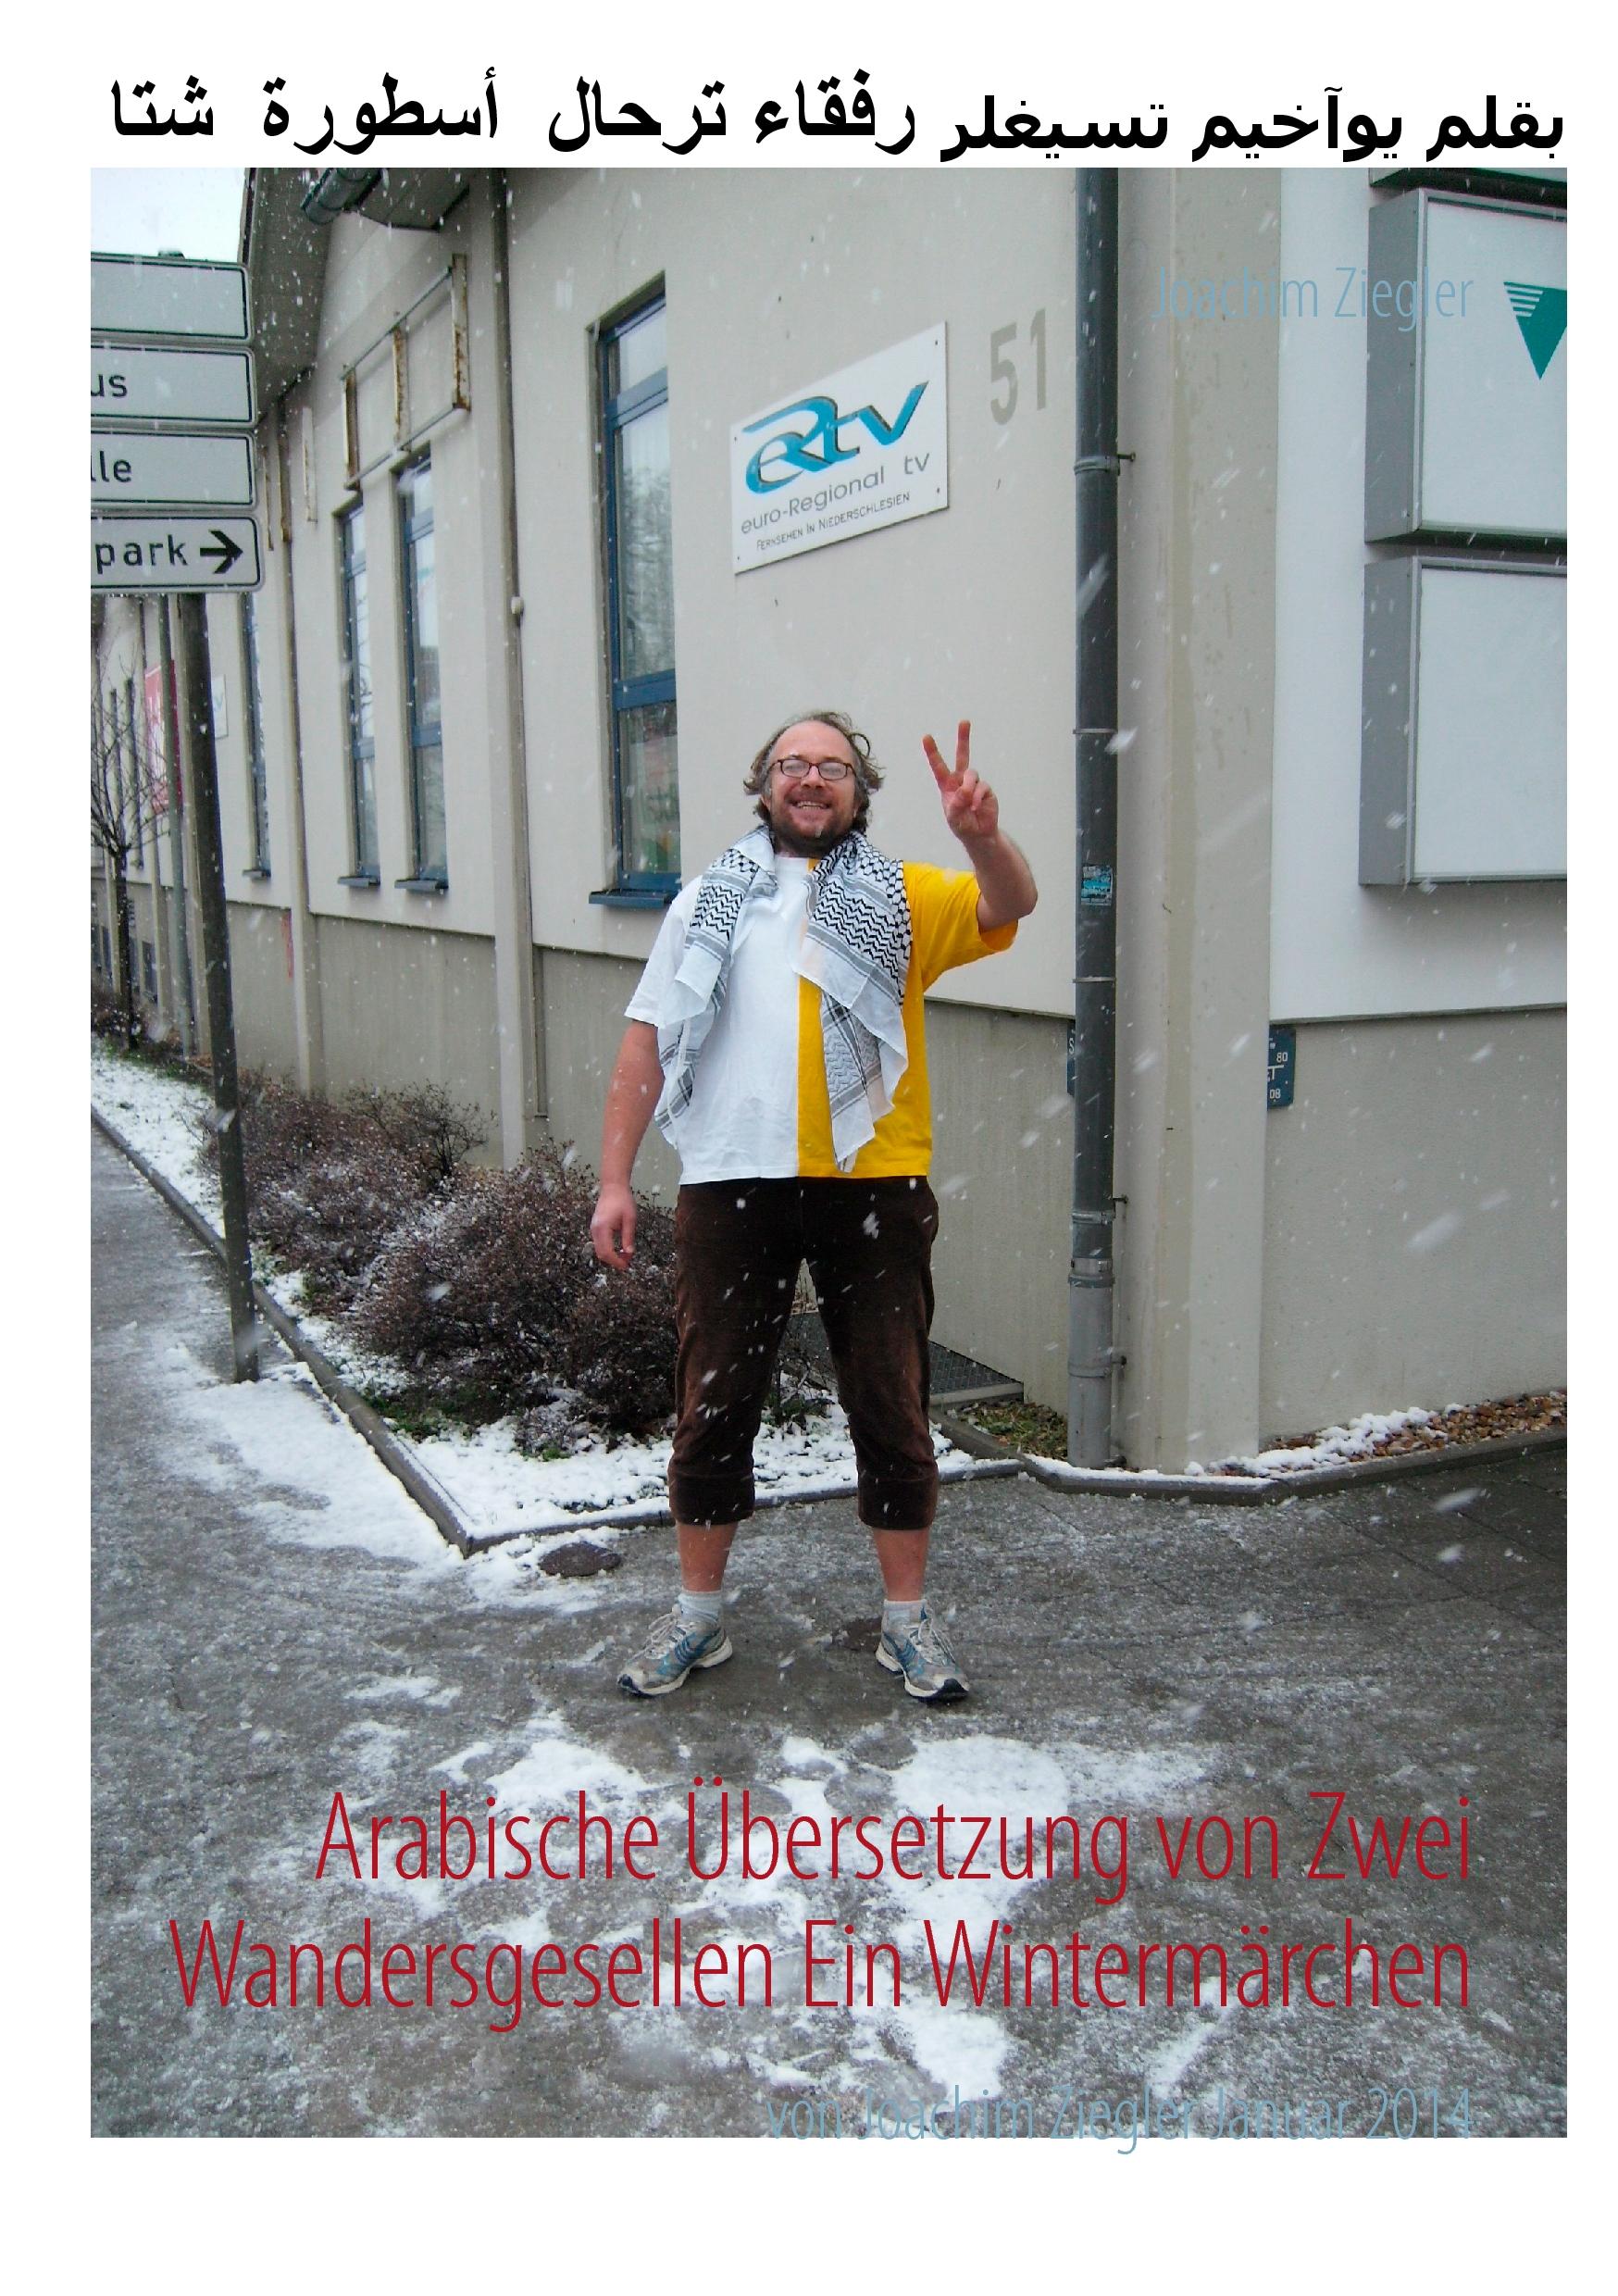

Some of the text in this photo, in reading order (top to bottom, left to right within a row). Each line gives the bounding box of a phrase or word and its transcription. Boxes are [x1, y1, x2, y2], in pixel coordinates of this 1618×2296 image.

[989, 308, 1047, 426] 51
[741, 452, 929, 534] euro-Regional tv
[94, 533, 188, 575] park
